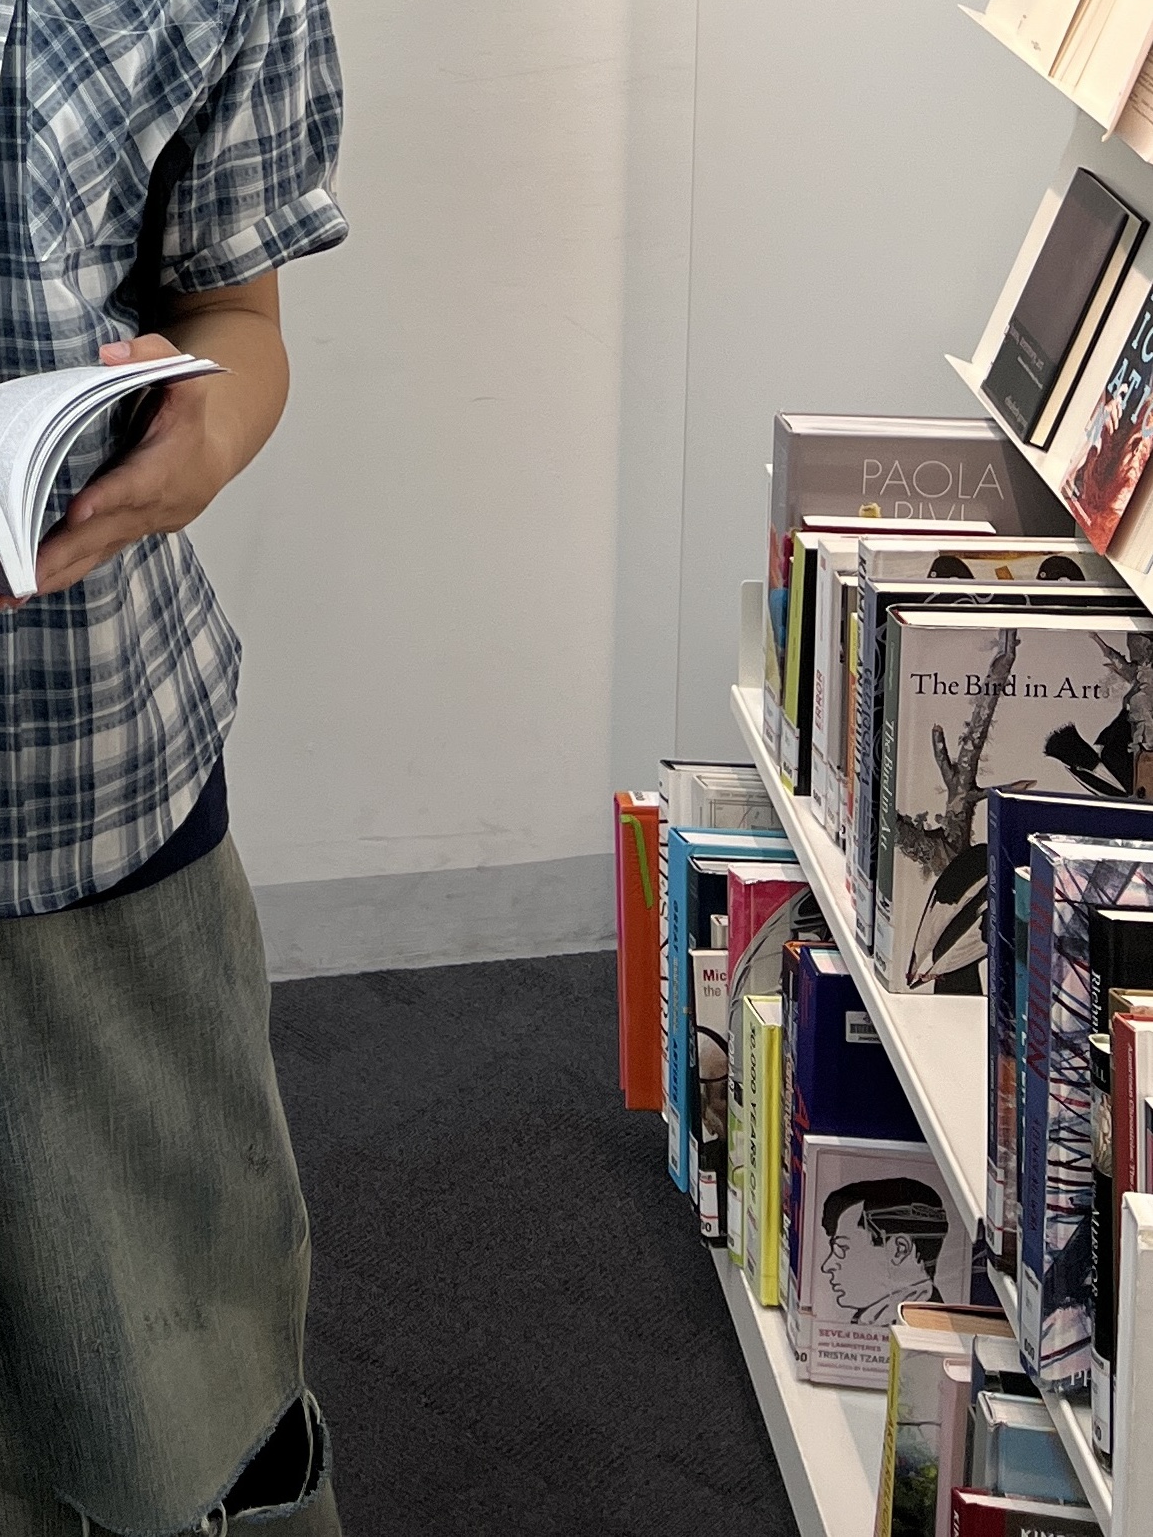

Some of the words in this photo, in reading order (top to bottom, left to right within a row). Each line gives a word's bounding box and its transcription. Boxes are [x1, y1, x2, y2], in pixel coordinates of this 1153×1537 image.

[862, 458, 1005, 500] PAOLA
[910, 672, 959, 696] The
[964, 674, 1017, 698] Bird
[1024, 675, 1048, 698] in
[1053, 677, 1101, 699] Art
[884, 718, 895, 753] The
[881, 756, 893, 796] Bird
[703, 984, 722, 997] the
[749, 1101, 757, 1167] YEARS
[818, 1328, 850, 1339] SEVEN
[853, 1331, 879, 1342] DADA
[818, 1350, 857, 1362] TRISTAN
